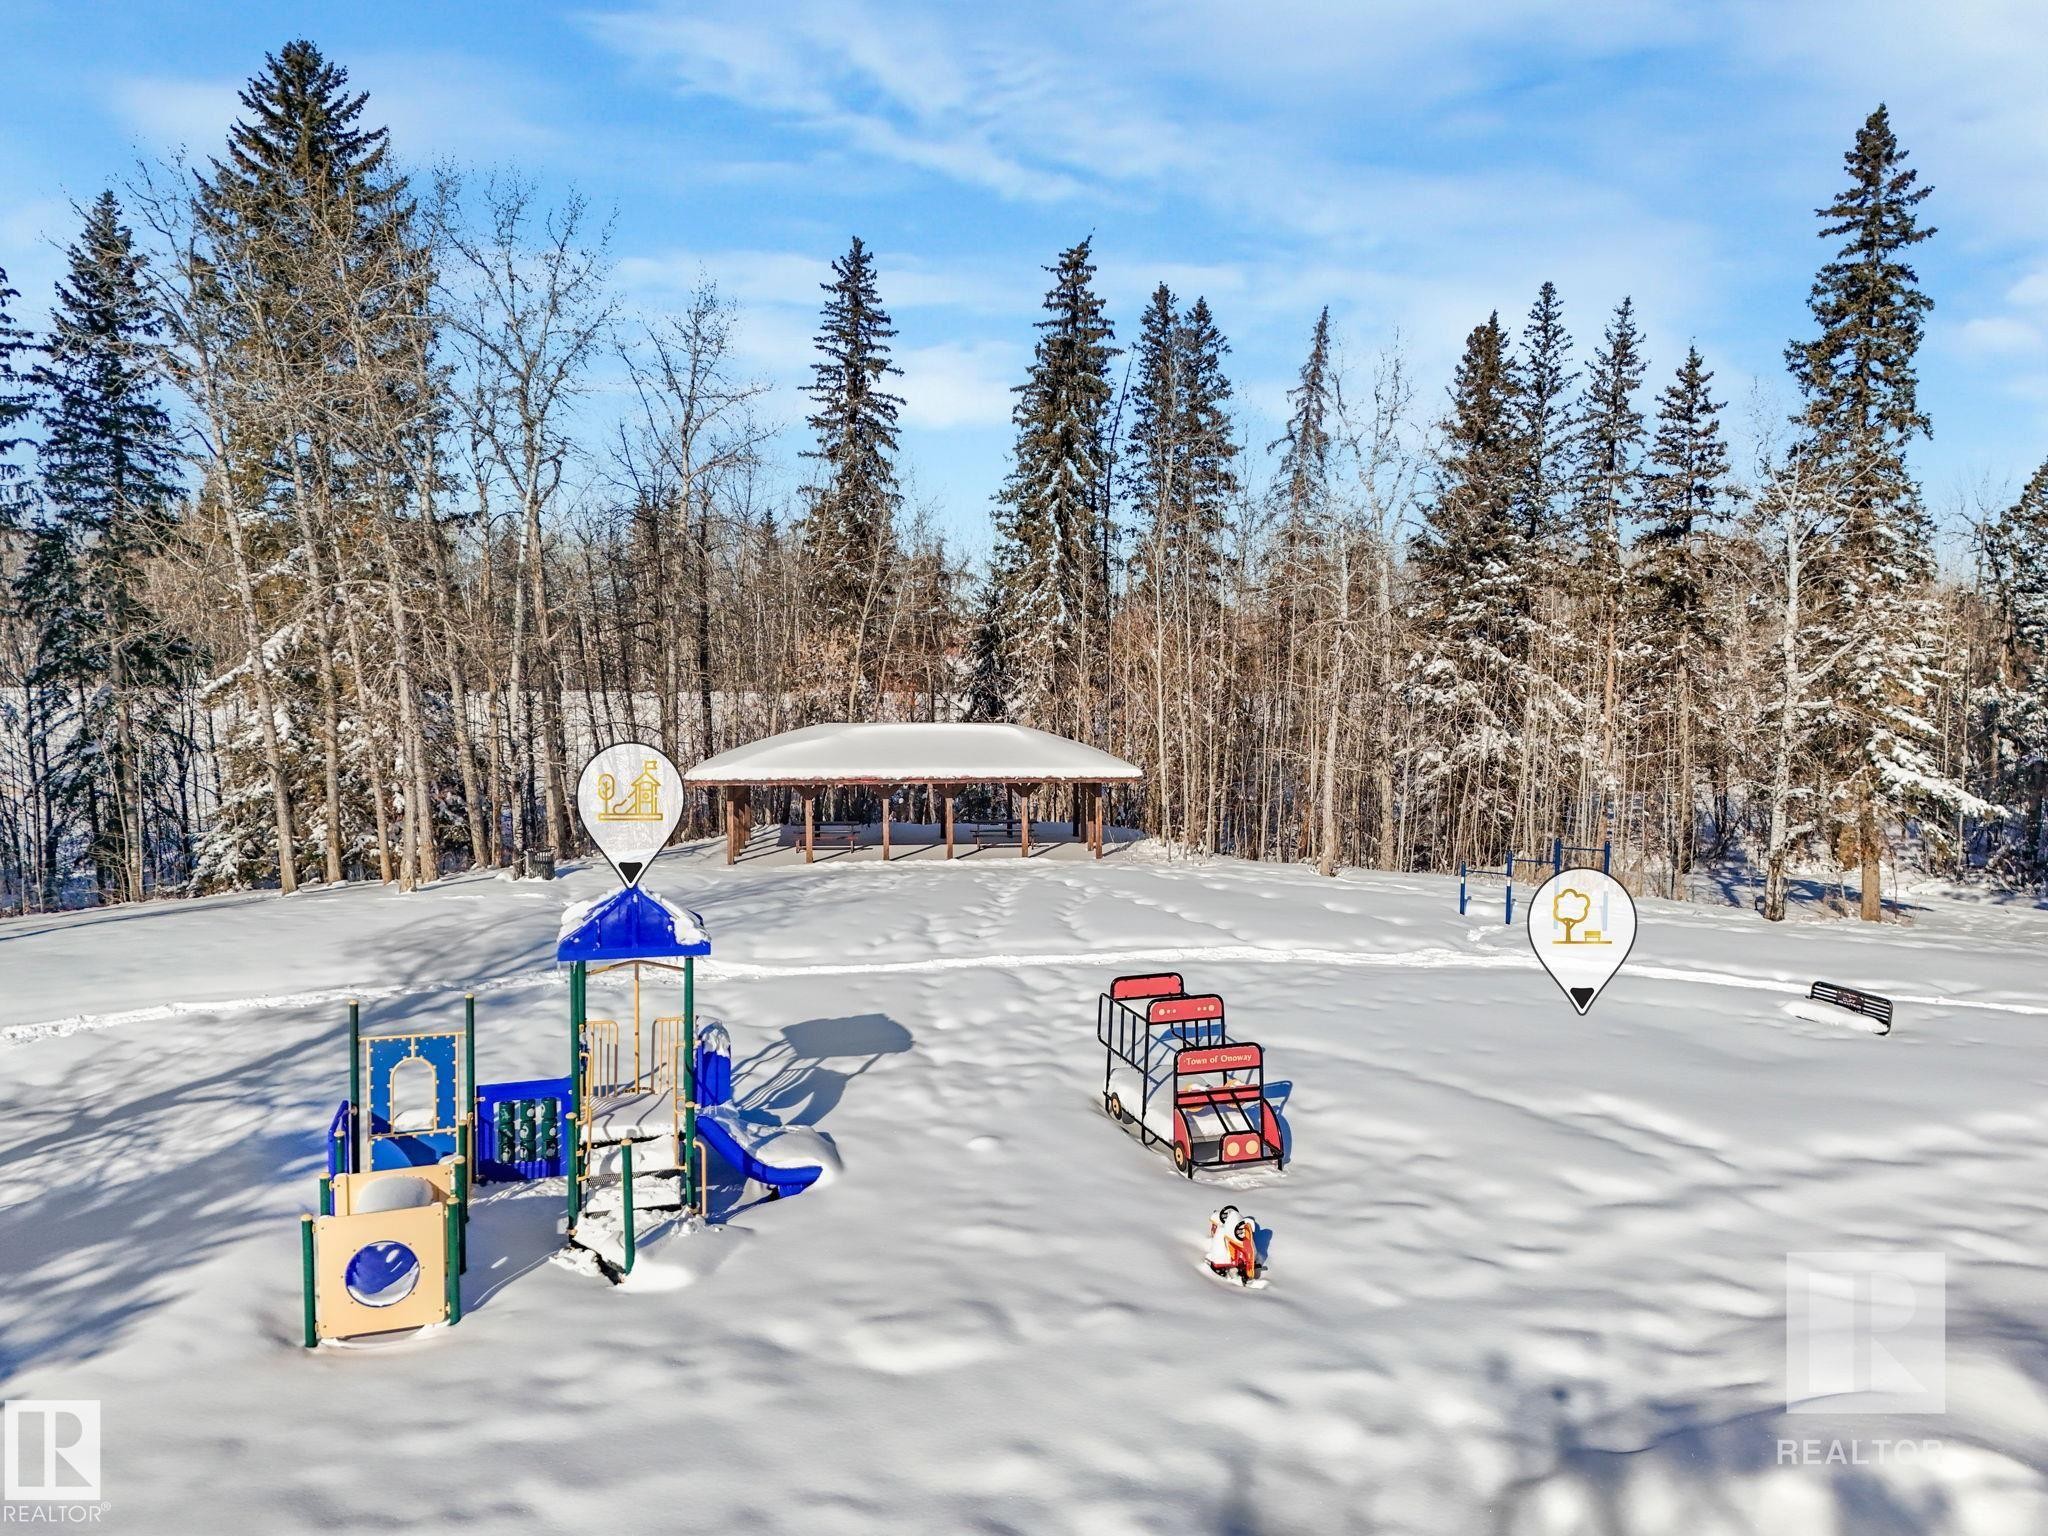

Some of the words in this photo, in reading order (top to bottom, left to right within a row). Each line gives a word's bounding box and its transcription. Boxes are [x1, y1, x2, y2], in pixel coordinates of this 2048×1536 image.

[1186, 1057, 1207, 1066] Town
[1210, 1055, 1218, 1064] of
[1220, 1053, 1252, 1063] Onoway
